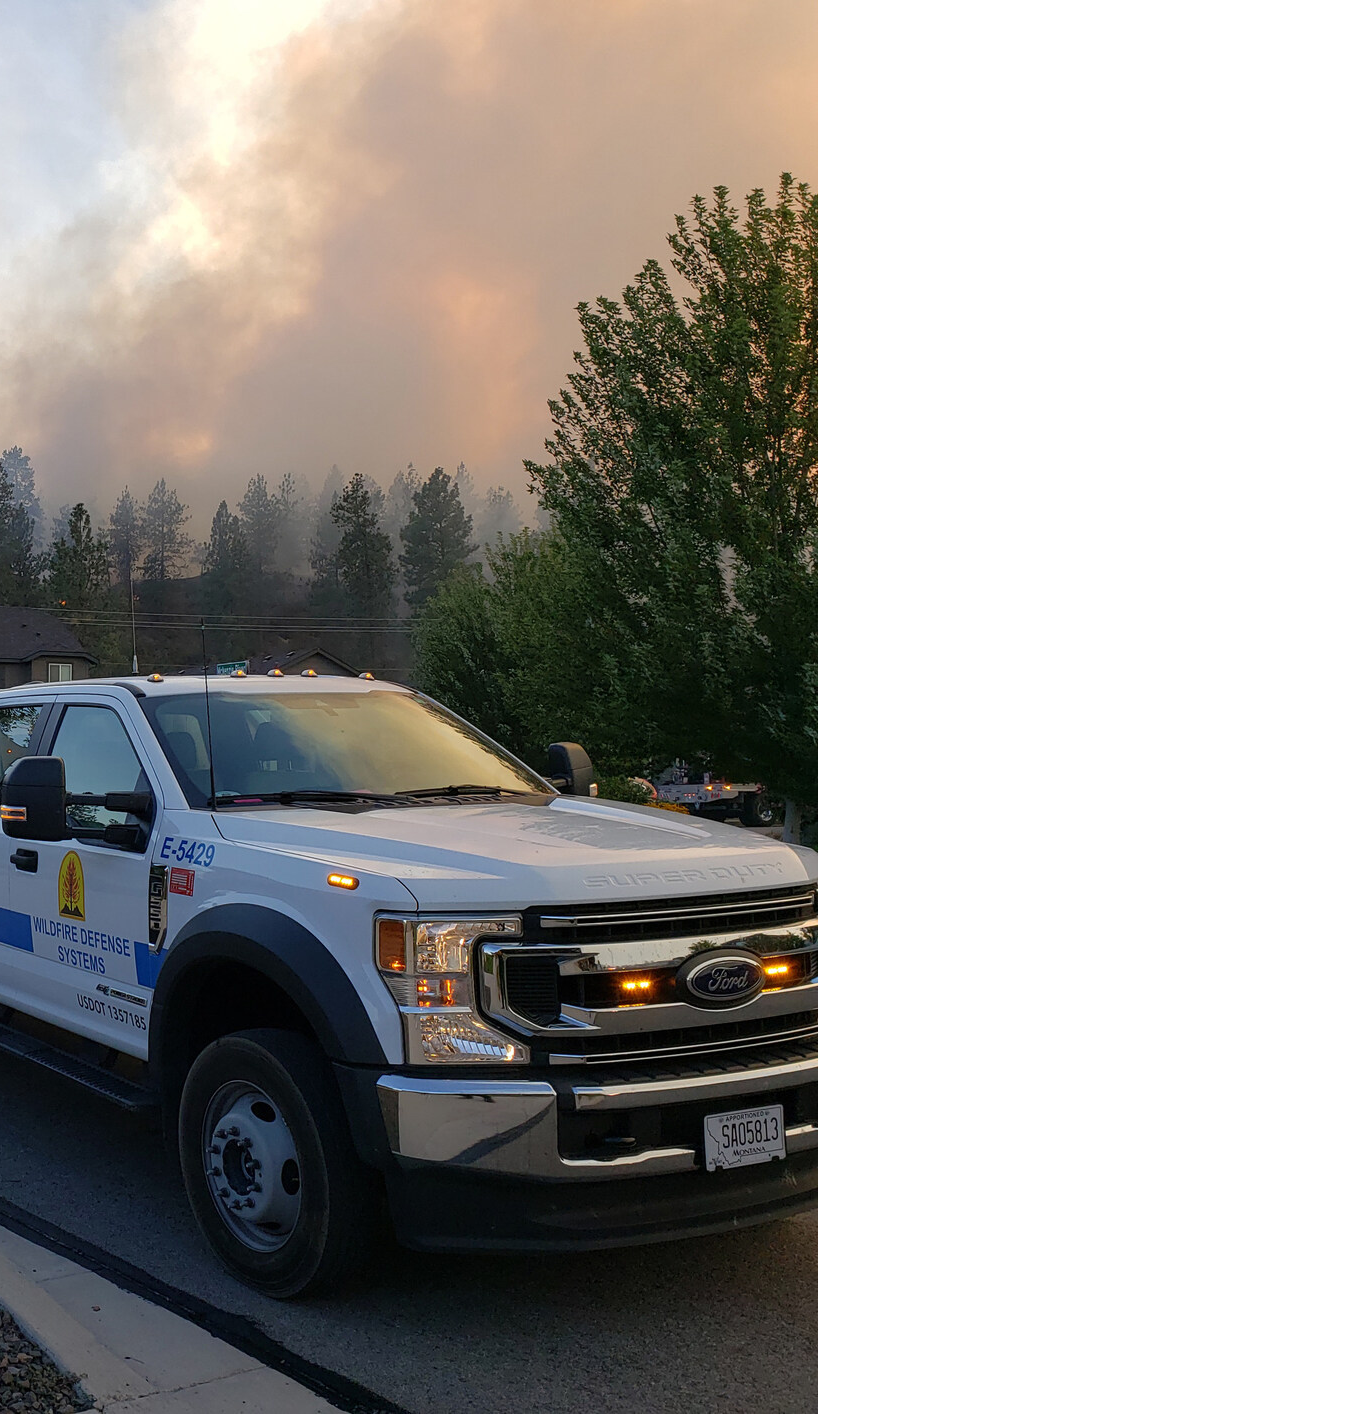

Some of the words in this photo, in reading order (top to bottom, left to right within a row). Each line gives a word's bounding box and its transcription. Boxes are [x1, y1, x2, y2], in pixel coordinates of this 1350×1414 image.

[160, 836, 216, 867] E-5429
[583, 868, 707, 889] SUPER
[709, 861, 784, 882] DUTY
[33, 915, 79, 943] WILDFIRE
[80, 927, 131, 957] DEFENSE
[57, 945, 106, 975] SYSTEMS
[708, 966, 750, 992] Ford
[76, 993, 106, 1016] USDOT
[107, 1005, 147, 1031] 1357185
[725, 1110, 765, 1122] APPORTIONED
[721, 1117, 779, 1149] SA05813
[732, 1146, 766, 1157] MONTANA
